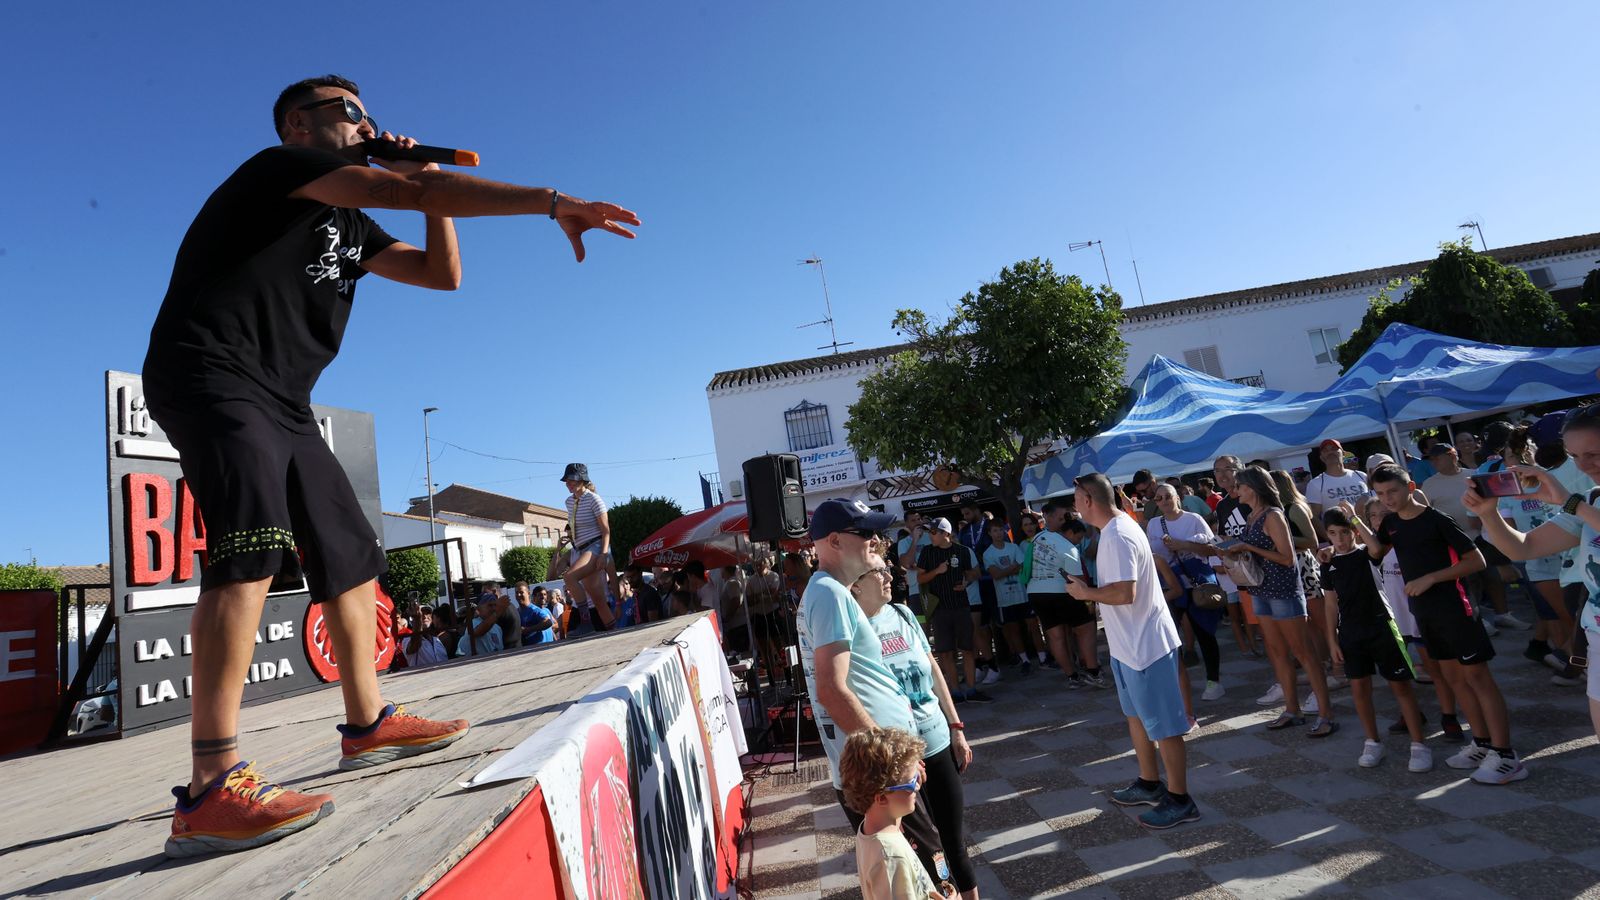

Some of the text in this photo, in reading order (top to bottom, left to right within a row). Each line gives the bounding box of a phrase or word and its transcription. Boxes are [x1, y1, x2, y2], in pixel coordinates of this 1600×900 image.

[810, 476, 828, 486] 313
[830, 472, 848, 482] 105
[135, 637, 175, 662] LA
[268, 620, 294, 642] DE
[881, 635, 909, 656] ARRO
[138, 679, 179, 706] LA
